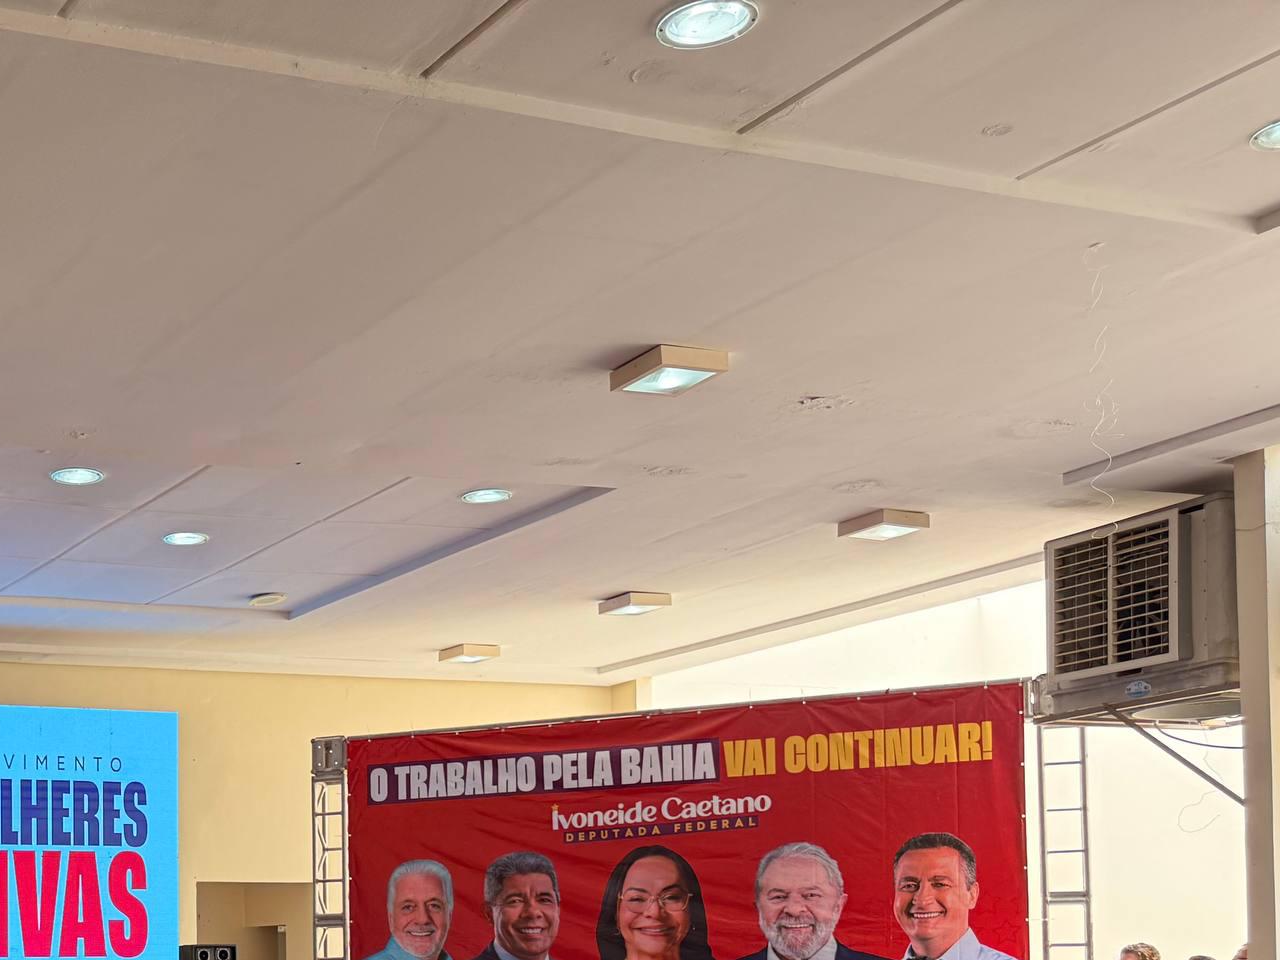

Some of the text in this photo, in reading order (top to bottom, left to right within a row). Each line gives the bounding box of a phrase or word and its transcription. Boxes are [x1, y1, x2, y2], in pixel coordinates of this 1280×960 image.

[370, 720, 993, 803] O TRABALHO PELA BAHIA VAI CONTINUAR!
[551, 794, 772, 831] Ivoneide Caetano
[565, 816, 756, 843] DEPUTADA FEDERAL
